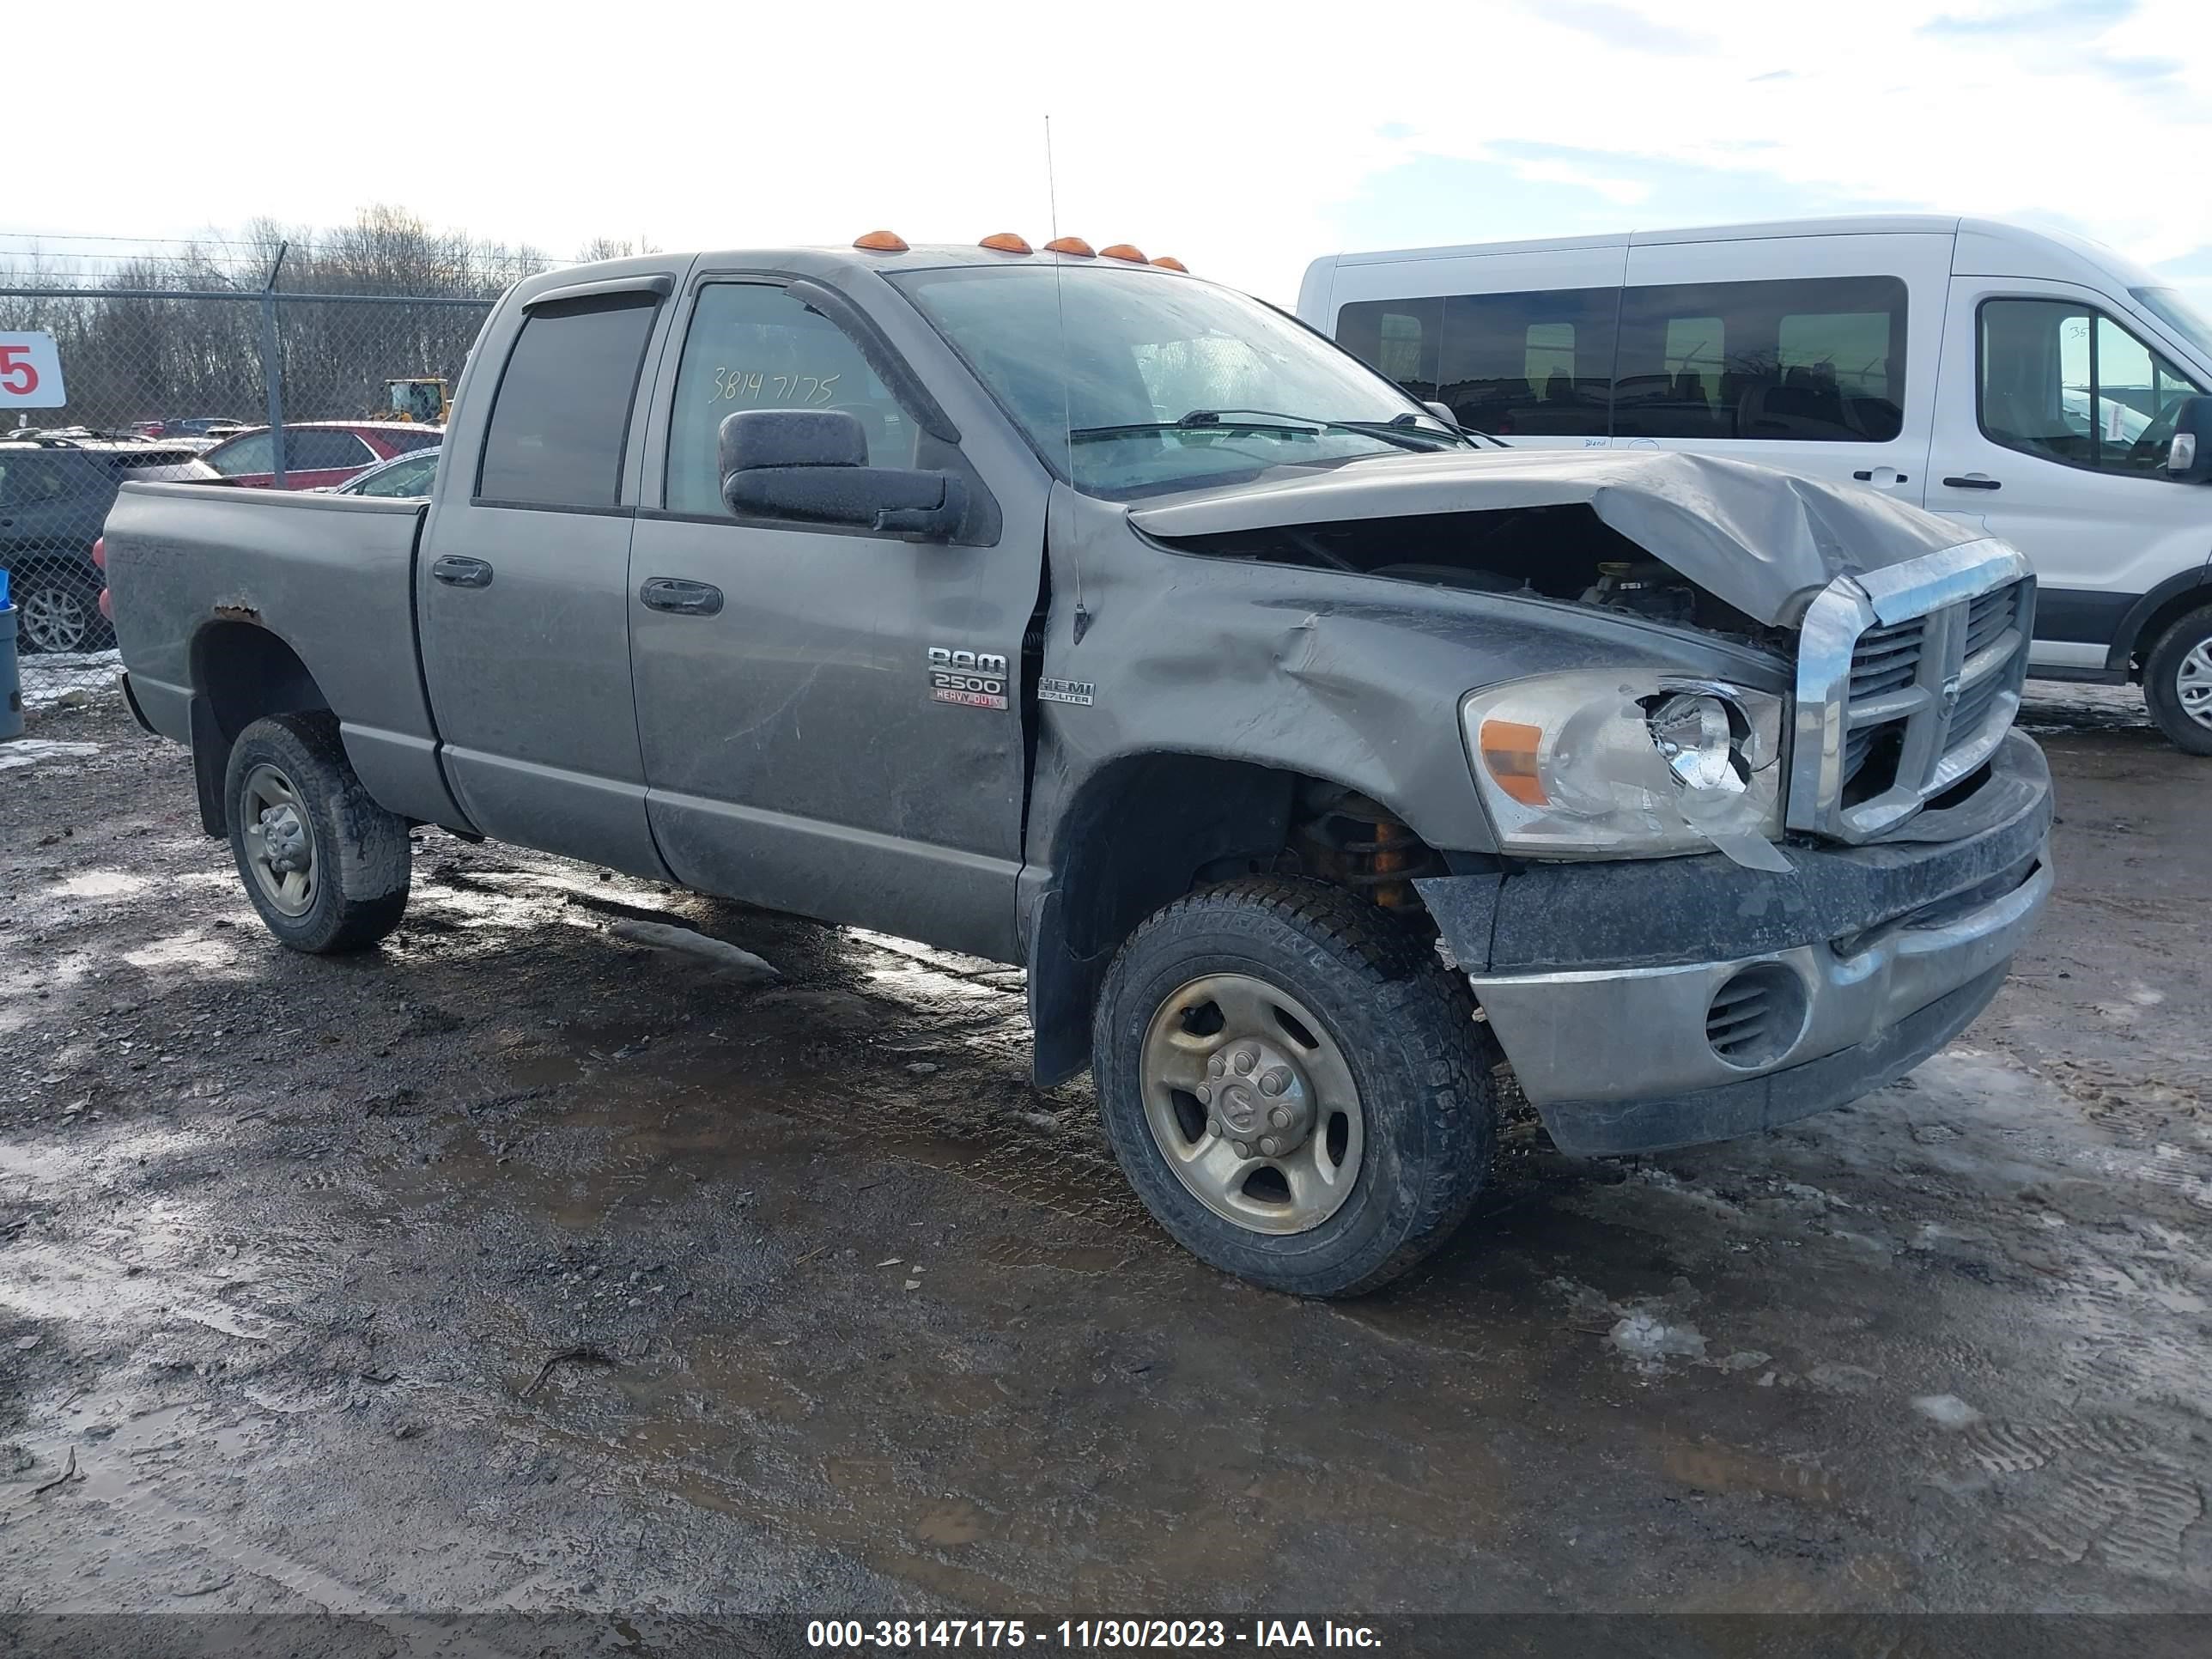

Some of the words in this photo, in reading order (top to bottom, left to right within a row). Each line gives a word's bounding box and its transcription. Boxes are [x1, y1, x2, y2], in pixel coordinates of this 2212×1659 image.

[928, 647, 1006, 674] RAM
[934, 673, 1001, 694] 2500
[1039, 678, 1092, 696] HEMI
[937, 690, 969, 702] HEAVY
[974, 694, 1002, 707] DUTY
[1058, 693, 1090, 703] LITER
